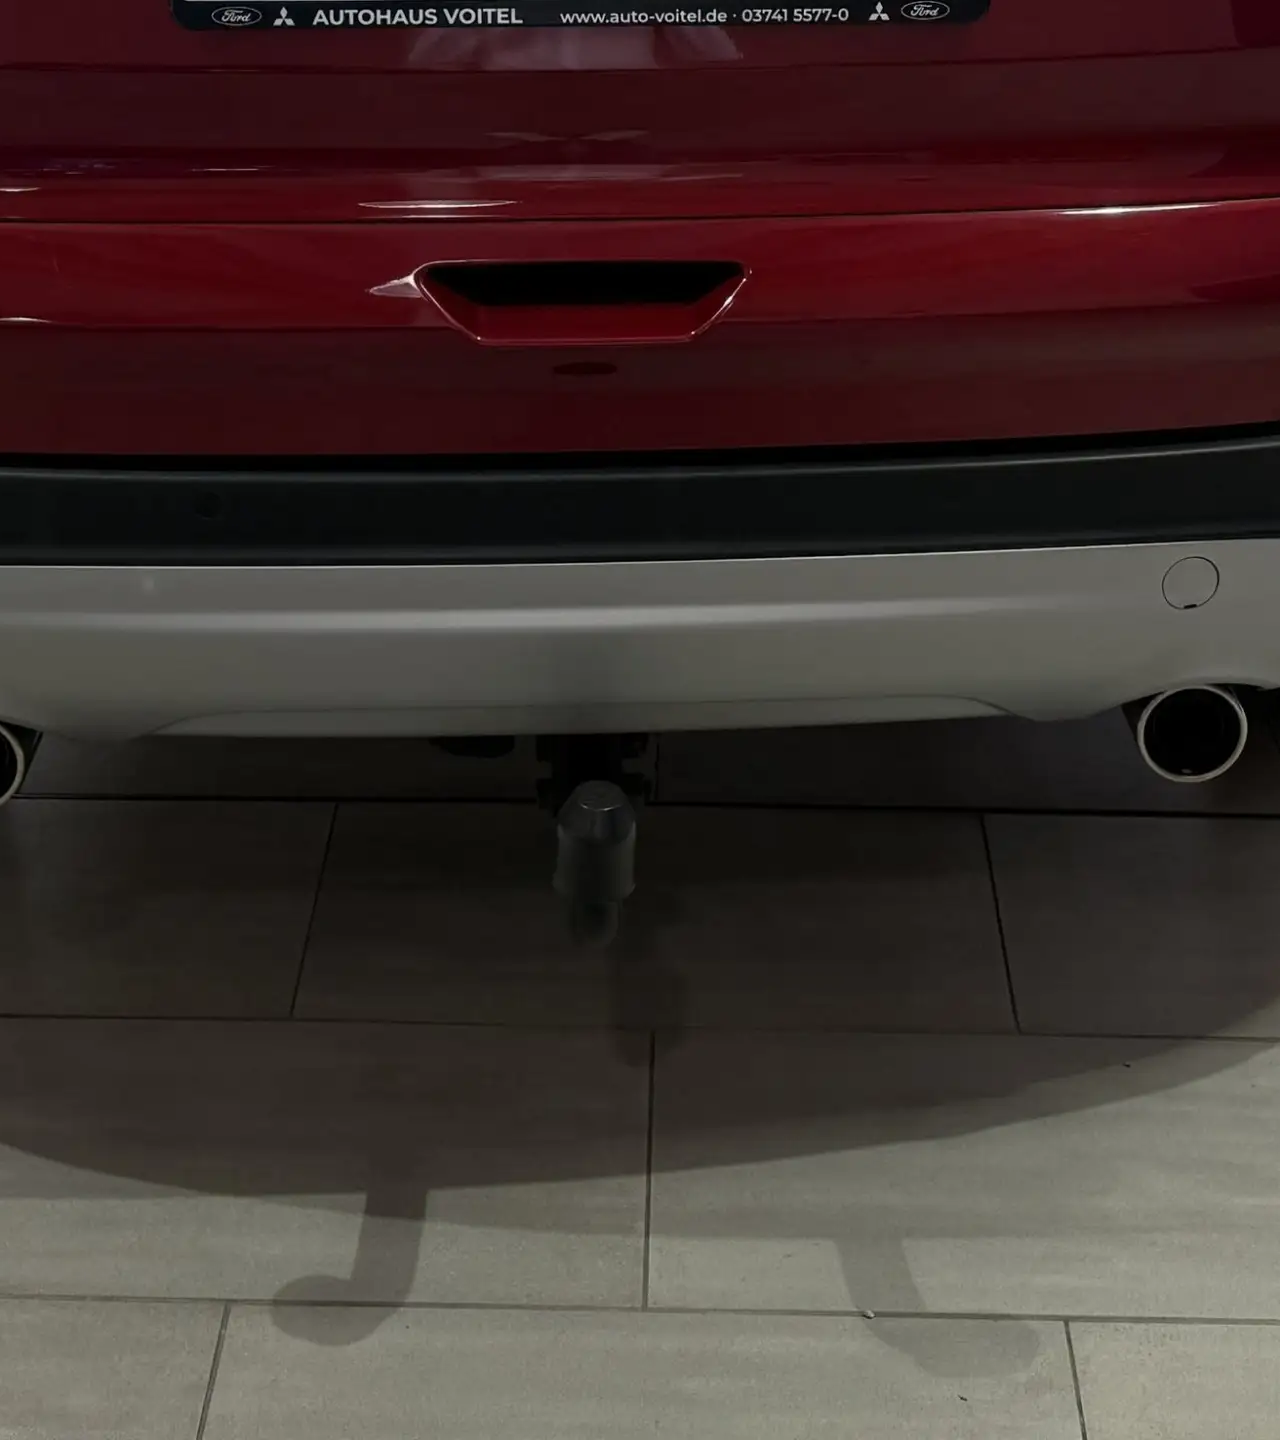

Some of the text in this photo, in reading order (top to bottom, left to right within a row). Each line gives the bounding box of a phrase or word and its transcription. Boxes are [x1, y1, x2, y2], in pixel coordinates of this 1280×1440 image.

[312, 8, 438, 25] AUTOHAUS
[443, 7, 524, 25] VOITEL
[560, 8, 727, 25] www.auto-voitel.de
[741, 8, 789, 23] 03741
[793, 7, 850, 23] 5577-0
